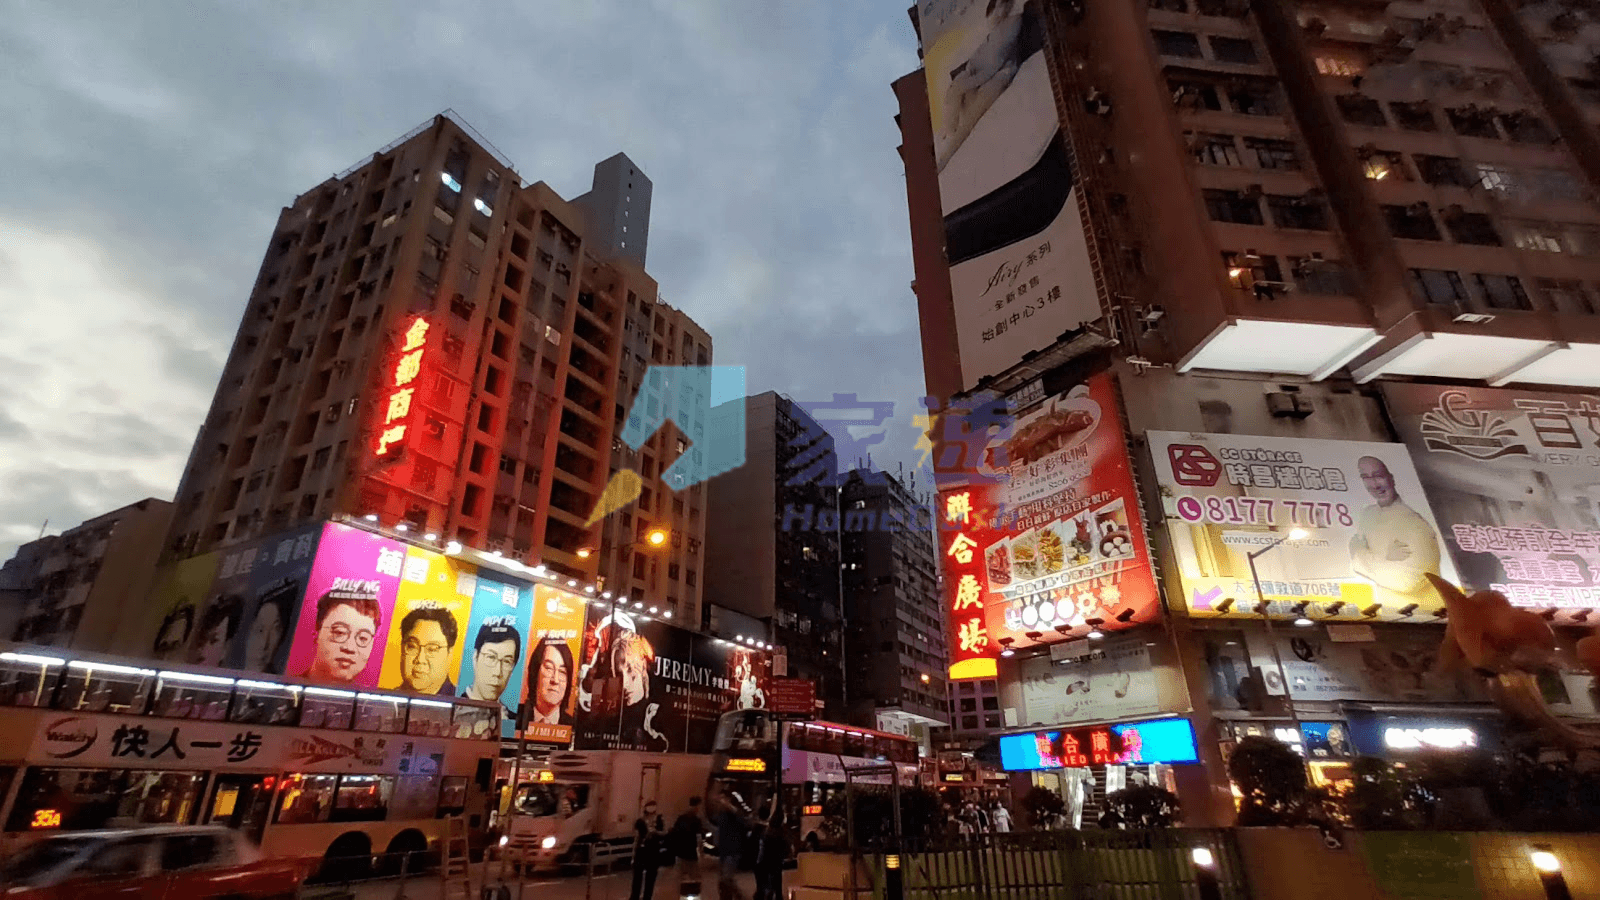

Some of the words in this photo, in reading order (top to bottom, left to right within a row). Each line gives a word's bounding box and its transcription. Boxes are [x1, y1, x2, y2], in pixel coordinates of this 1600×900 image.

[1026, 241, 1052, 267] 系列
[994, 275, 1040, 311] 全新發售
[981, 285, 1062, 343] 始創中心3樓
[1220, 448, 1240, 461] SC
[1241, 448, 1303, 463] STORAGE
[1224, 463, 1348, 491] 時昌迷你倉
[1207, 496, 1275, 523] 8177
[1283, 500, 1354, 527] 7778
[1451, 524, 1600, 553] 歡迎預訂全年
[330, 577, 364, 592] BILLY
[363, 580, 381, 593] NG
[946, 491, 989, 654] 聯合廣場
[654, 656, 712, 687] JEREMY
[111, 724, 262, 762] 快人一步
[1037, 729, 1141, 754] 聯合廣場
[31, 809, 61, 828] 35A
